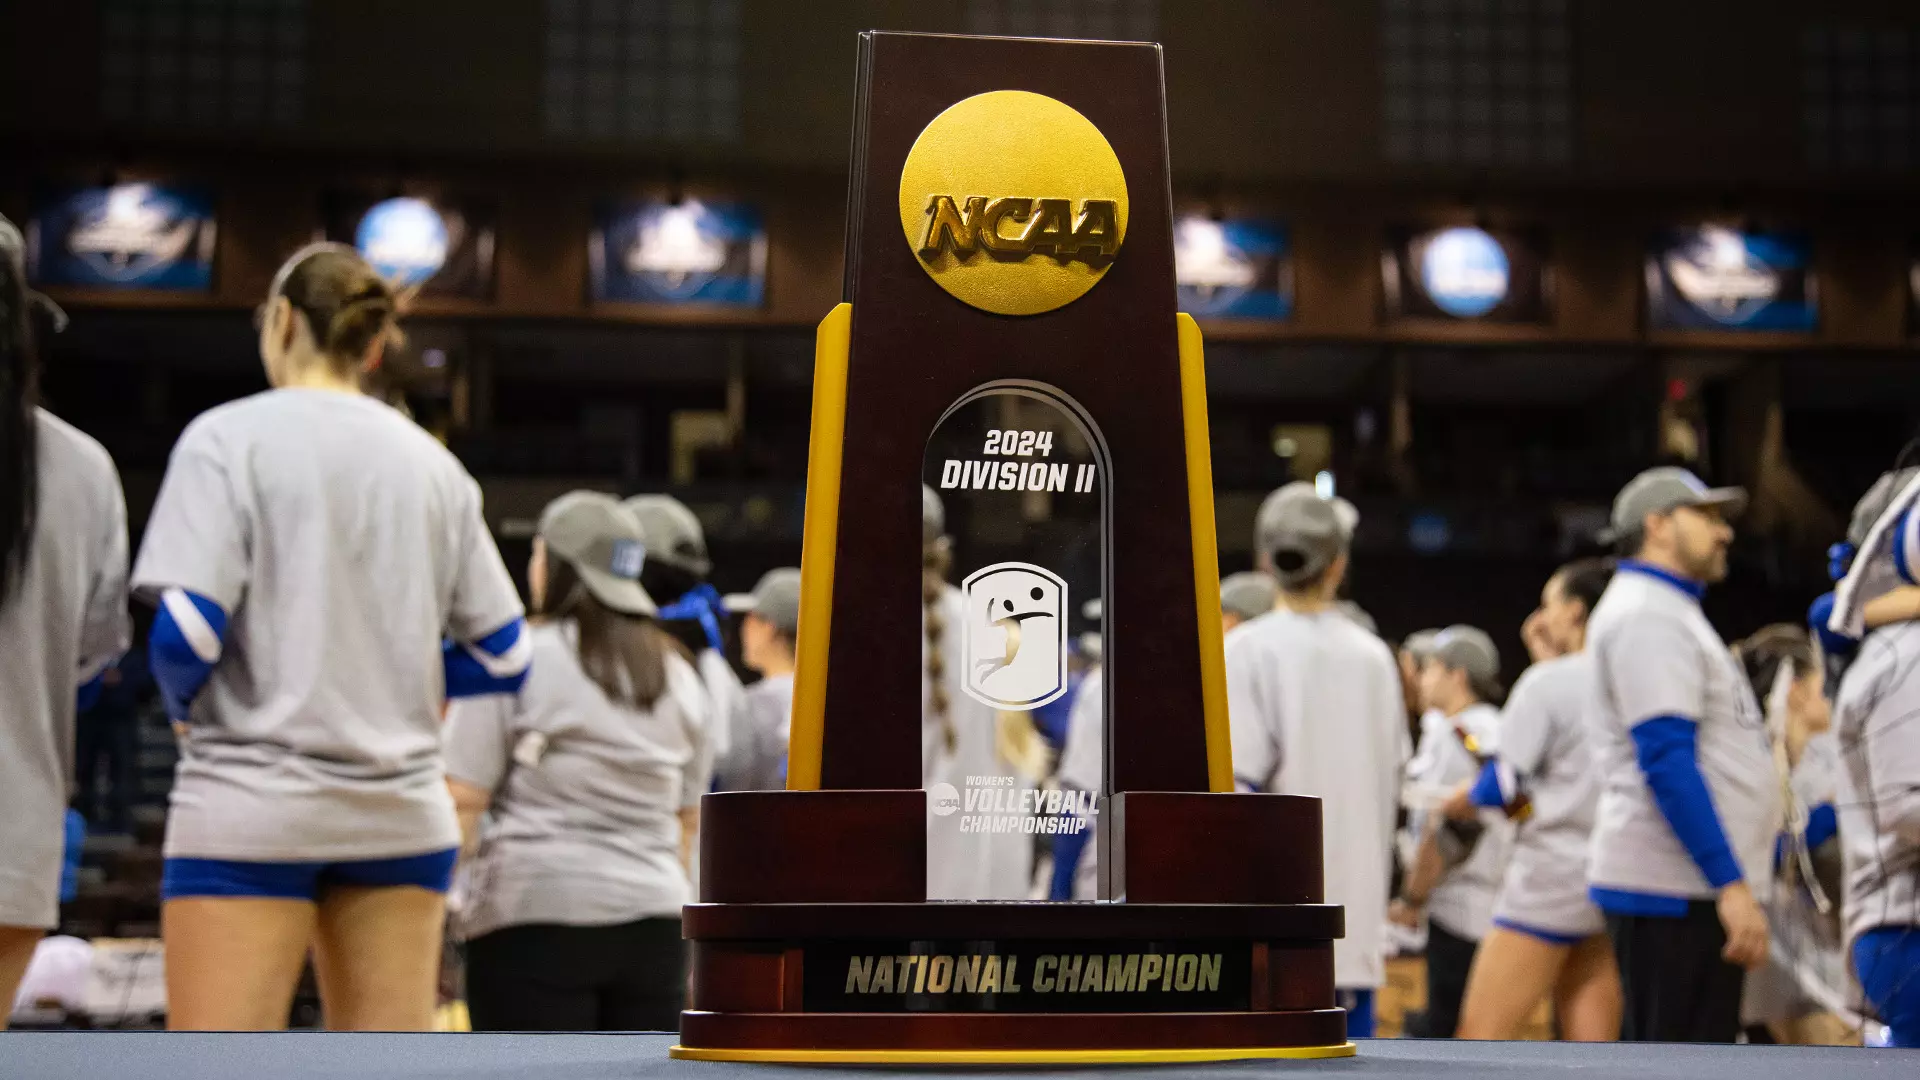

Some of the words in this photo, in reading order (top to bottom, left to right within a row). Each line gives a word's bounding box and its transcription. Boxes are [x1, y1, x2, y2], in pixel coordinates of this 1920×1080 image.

[919, 194, 1119, 256] NCAA
[983, 429, 1053, 457] 2024
[940, 459, 1069, 492] DIVISION
[1074, 464, 1096, 493] II
[965, 775, 1014, 786] WOMEN'S
[964, 788, 1100, 815] VOLLEYBALL
[959, 815, 1086, 835] CHAMPIONSHIP
[845, 955, 1021, 994] NATIONAL
[1032, 953, 1223, 993] CHAMPION
